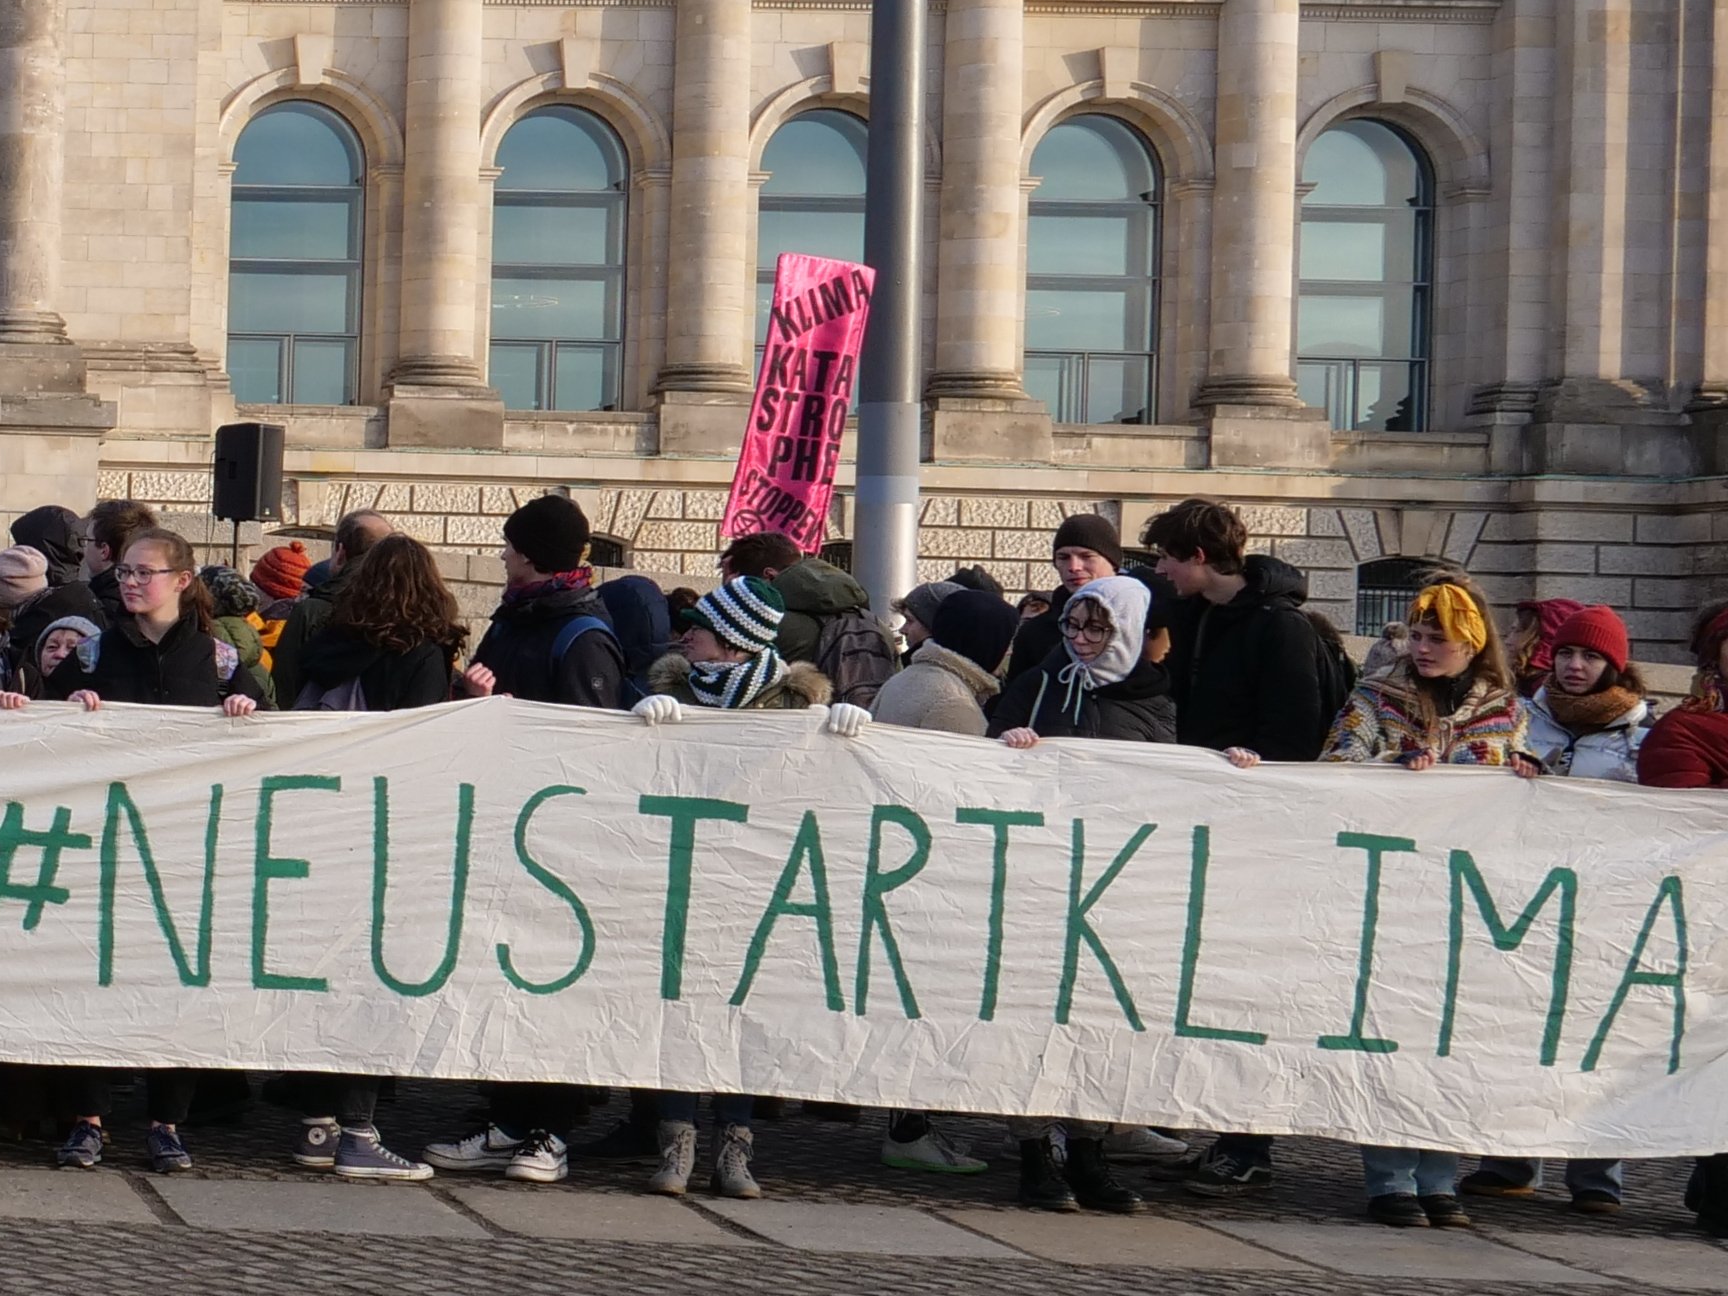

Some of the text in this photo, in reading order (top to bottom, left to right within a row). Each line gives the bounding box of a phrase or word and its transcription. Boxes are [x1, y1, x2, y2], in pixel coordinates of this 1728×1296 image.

[773, 269, 871, 343] KLIMA
[766, 345, 853, 397] KATA
[756, 387, 848, 442] STRO
[768, 436, 841, 485] PHE
[739, 468, 823, 549] STOPPEN
